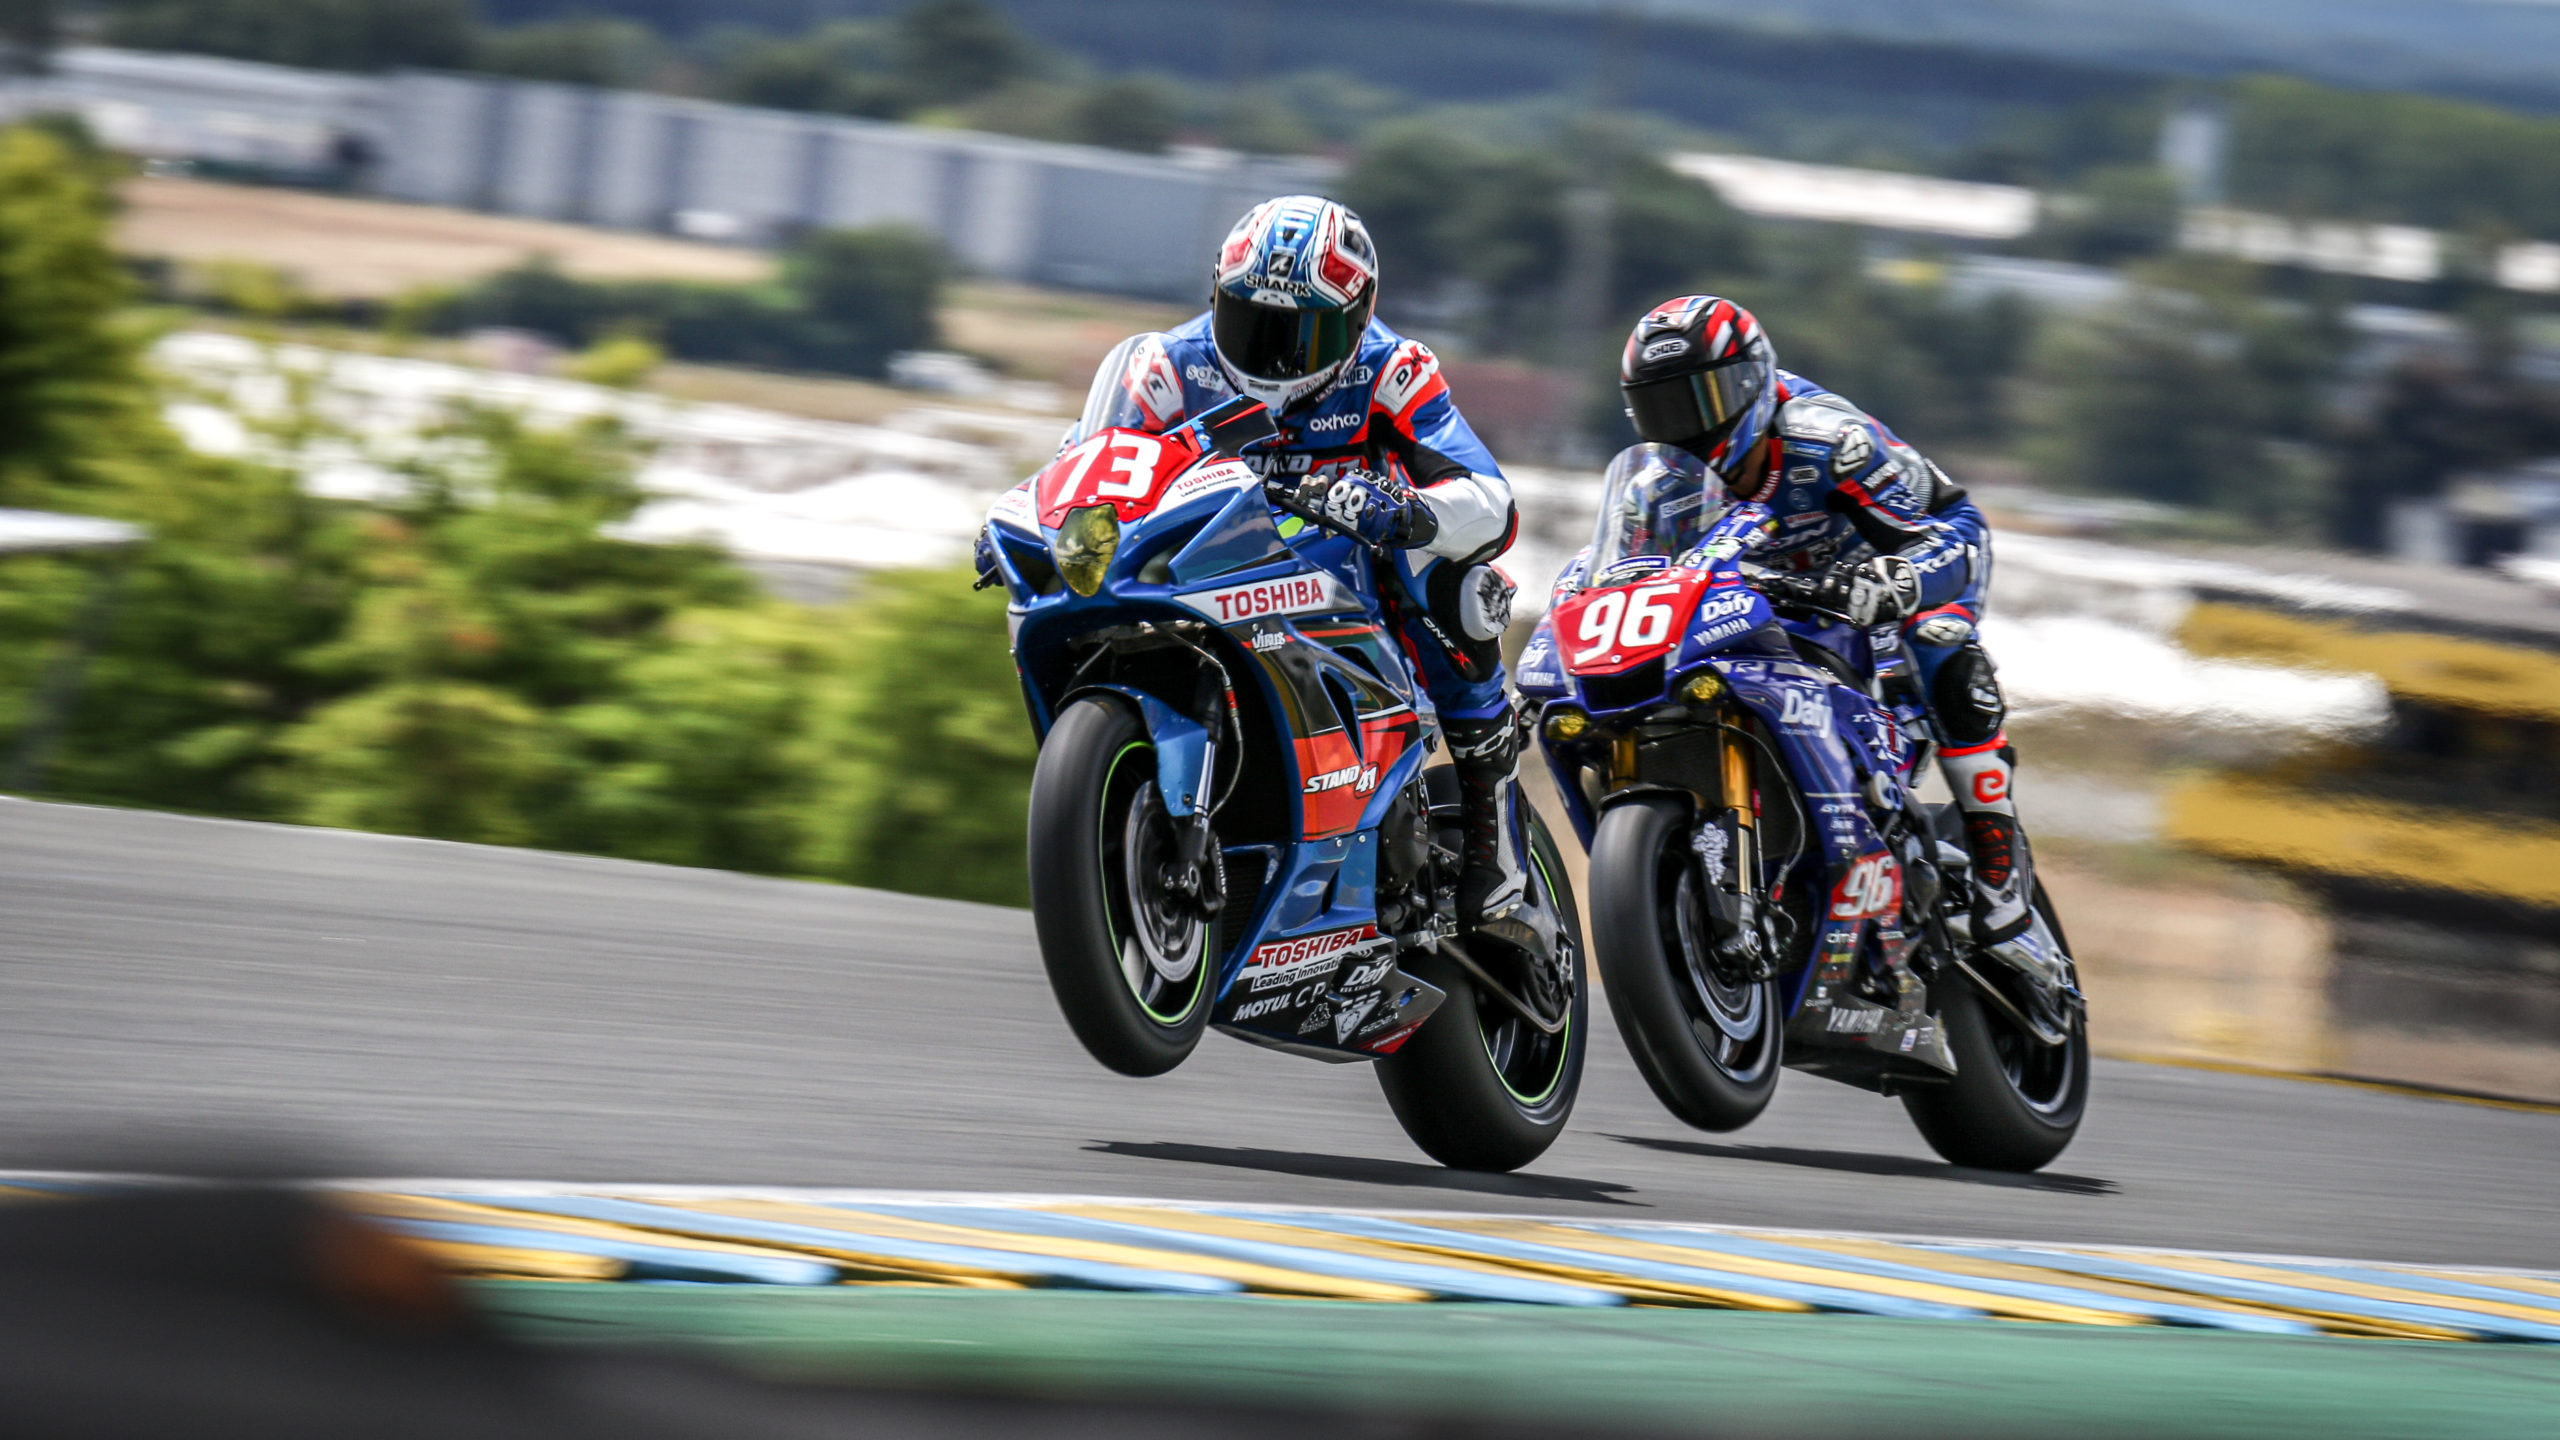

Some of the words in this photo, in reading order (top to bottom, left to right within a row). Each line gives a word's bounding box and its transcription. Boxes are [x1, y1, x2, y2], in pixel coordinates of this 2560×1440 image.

[1244, 273, 1312, 298] SHARK
[1053, 434, 1162, 507] 73
[1175, 467, 1236, 491] TOSHIBA
[1214, 578, 1325, 620] TOSHIBA
[1701, 592, 1756, 623] Dafy
[1573, 583, 1681, 666] 96
[1692, 617, 1752, 647] YAMAHA
[1779, 688, 1833, 739] Dafy
[1302, 765, 1361, 794] STAND
[1355, 765, 1378, 793] 41
[1833, 855, 1895, 917] 96
[1258, 928, 1364, 969] TOSHIBA
[1253, 971, 1297, 992] Leading
[1298, 956, 1341, 980] Innovati
[1232, 990, 1292, 1023] MOTUL
